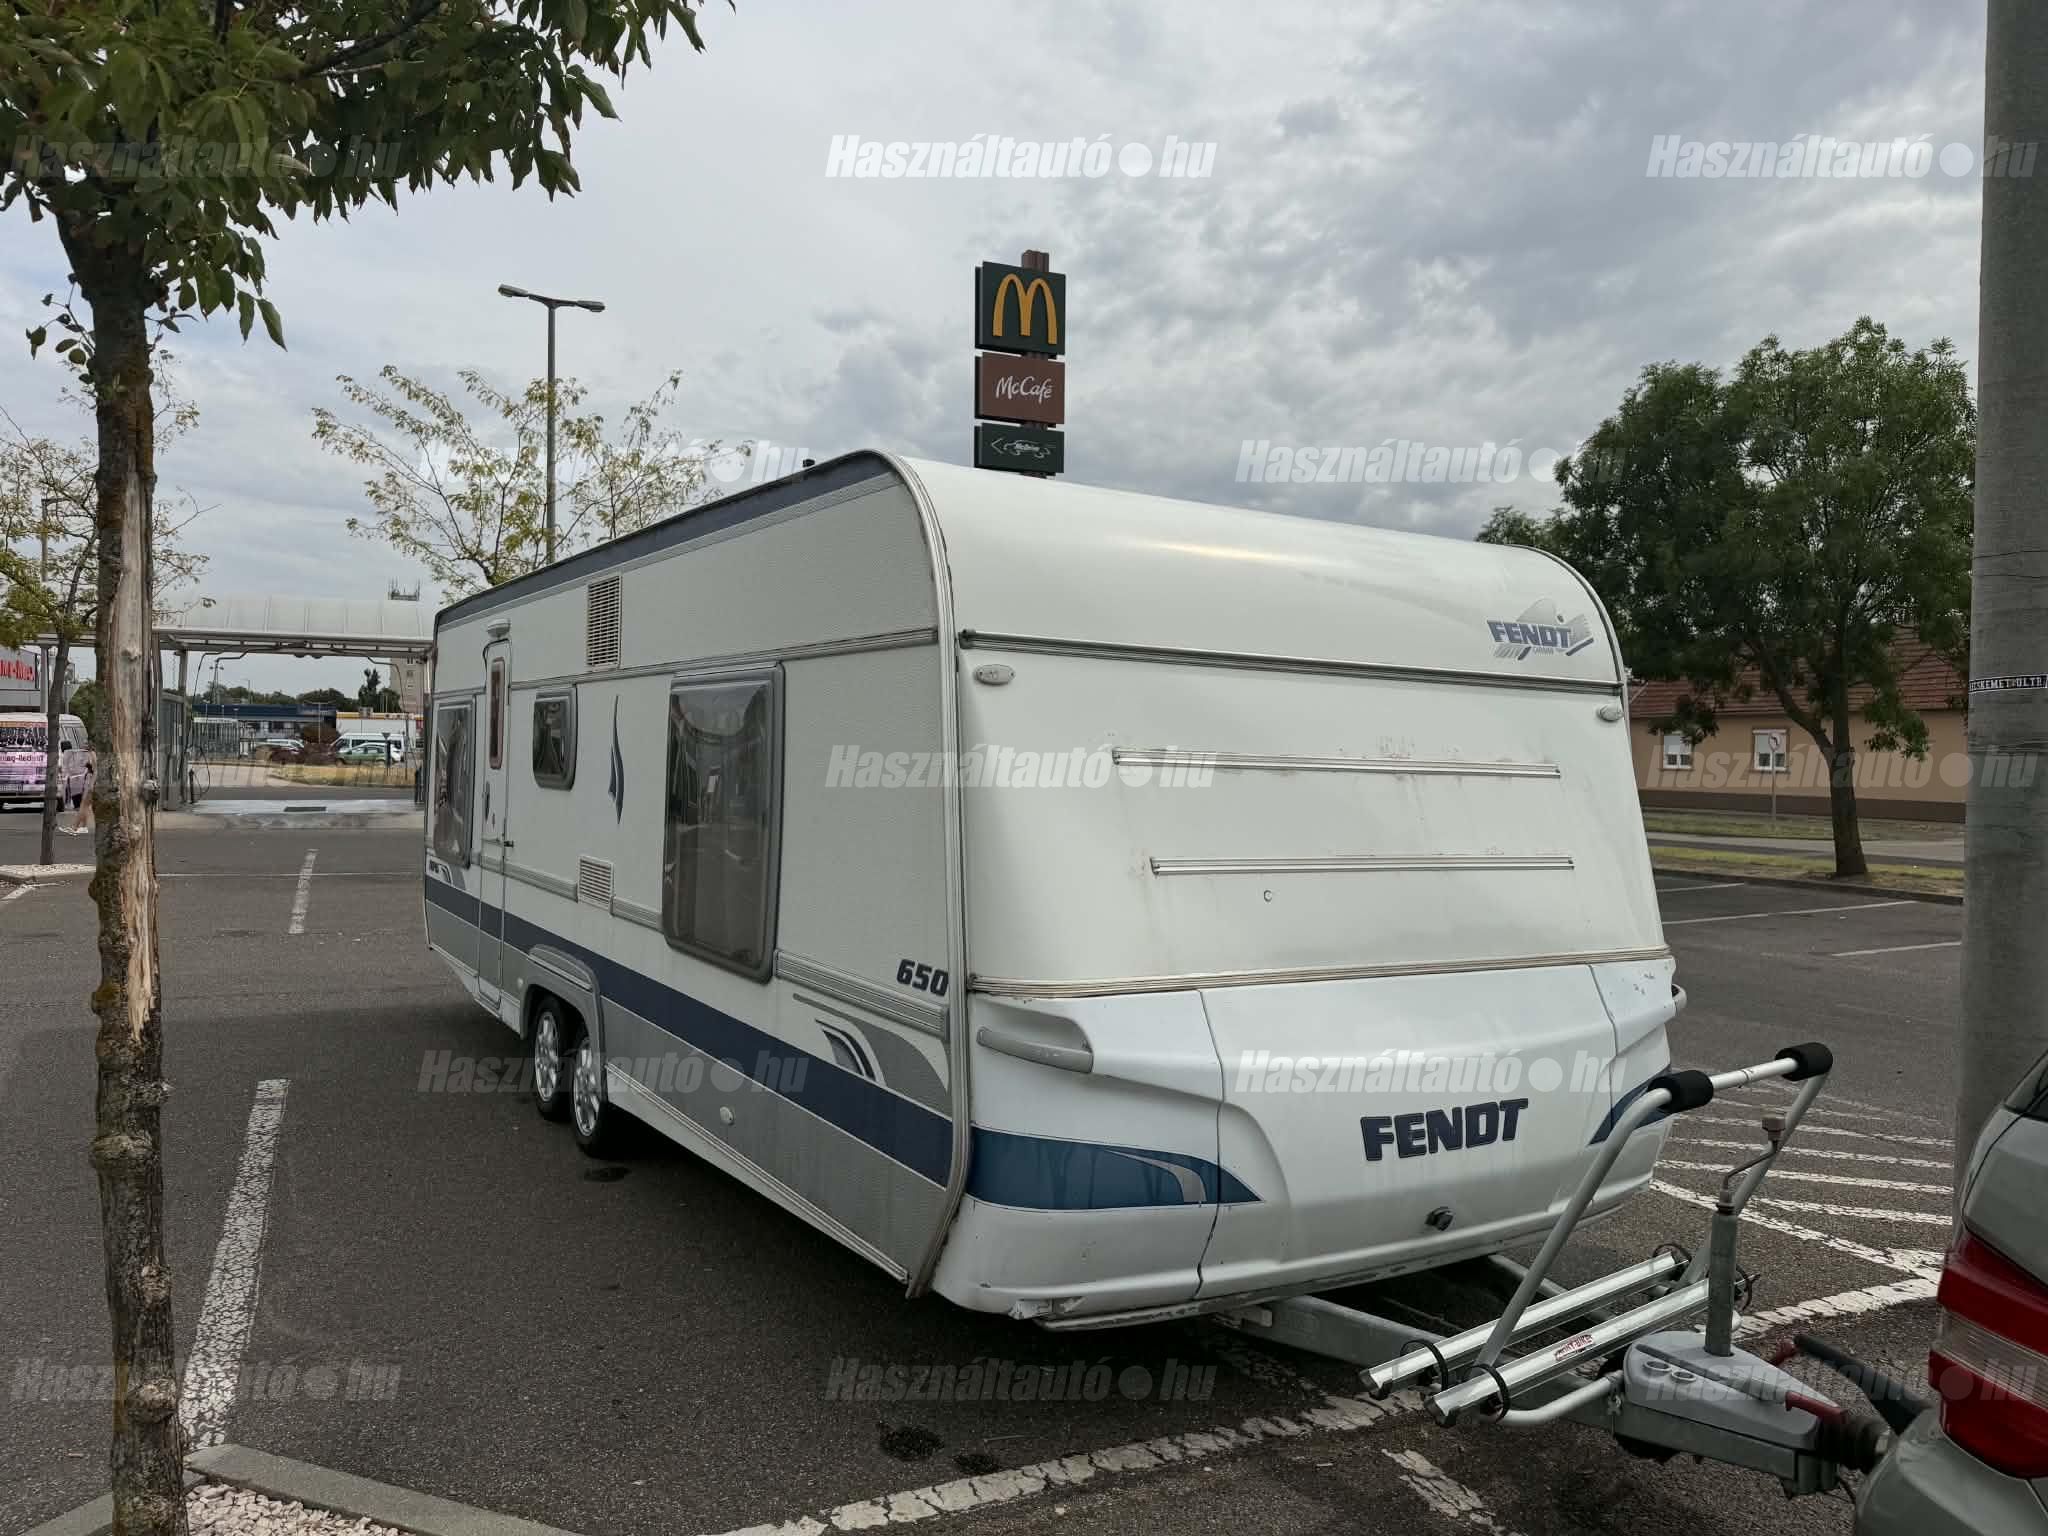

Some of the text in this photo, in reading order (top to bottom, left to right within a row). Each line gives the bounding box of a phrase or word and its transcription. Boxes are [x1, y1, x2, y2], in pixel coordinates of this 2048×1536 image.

[1487, 620, 1571, 648] FENDT
[897, 959, 949, 997] 650
[1360, 1098, 1528, 1161] FENDT
